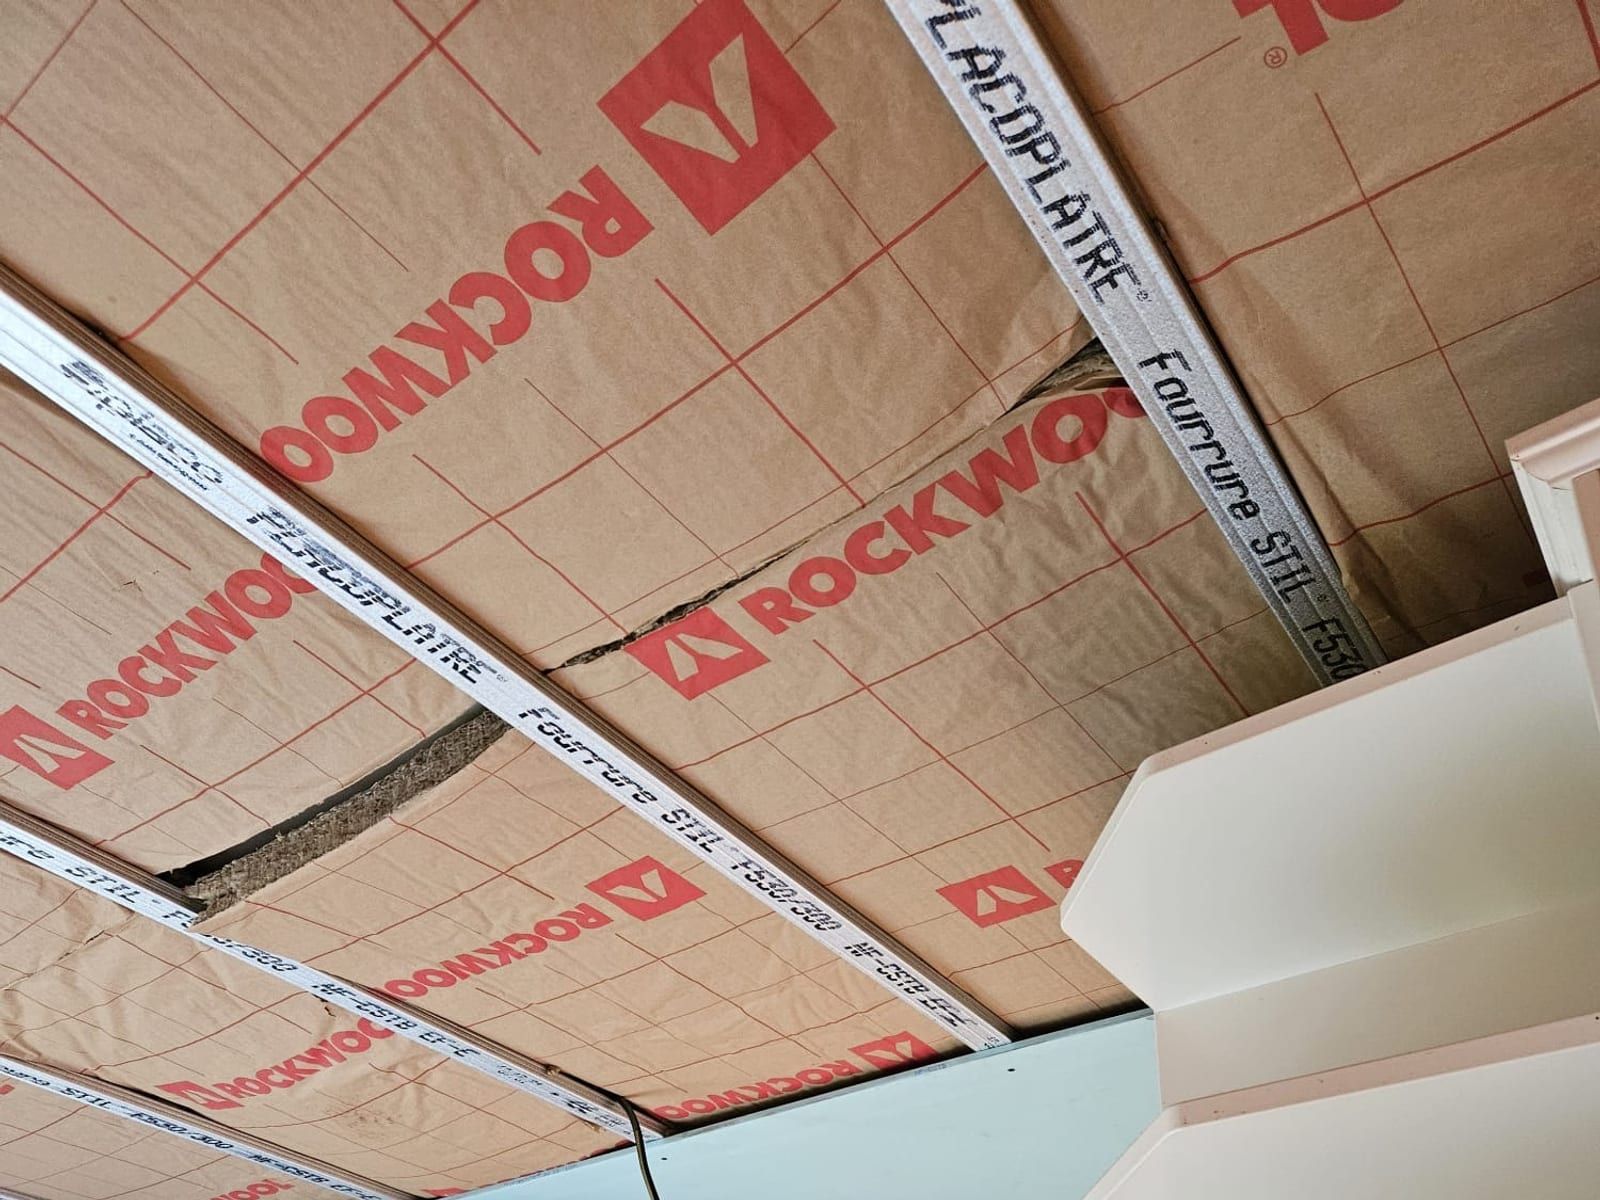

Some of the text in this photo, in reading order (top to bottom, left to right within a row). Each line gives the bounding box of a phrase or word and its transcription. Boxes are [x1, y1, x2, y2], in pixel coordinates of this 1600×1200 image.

[260, 164, 655, 483] ROCKWOO
[925, 0, 1142, 305] LACOPLATRE
[1137, 348, 1261, 521] Fourrure
[1250, 529, 1317, 603] STIL
[65, 866, 141, 904] STIL
[518, 706, 658, 805] Fourrure
[661, 807, 724, 853] STIL
[730, 857, 842, 931] F530/300
[209, 1178, 296, 1200] OOL
